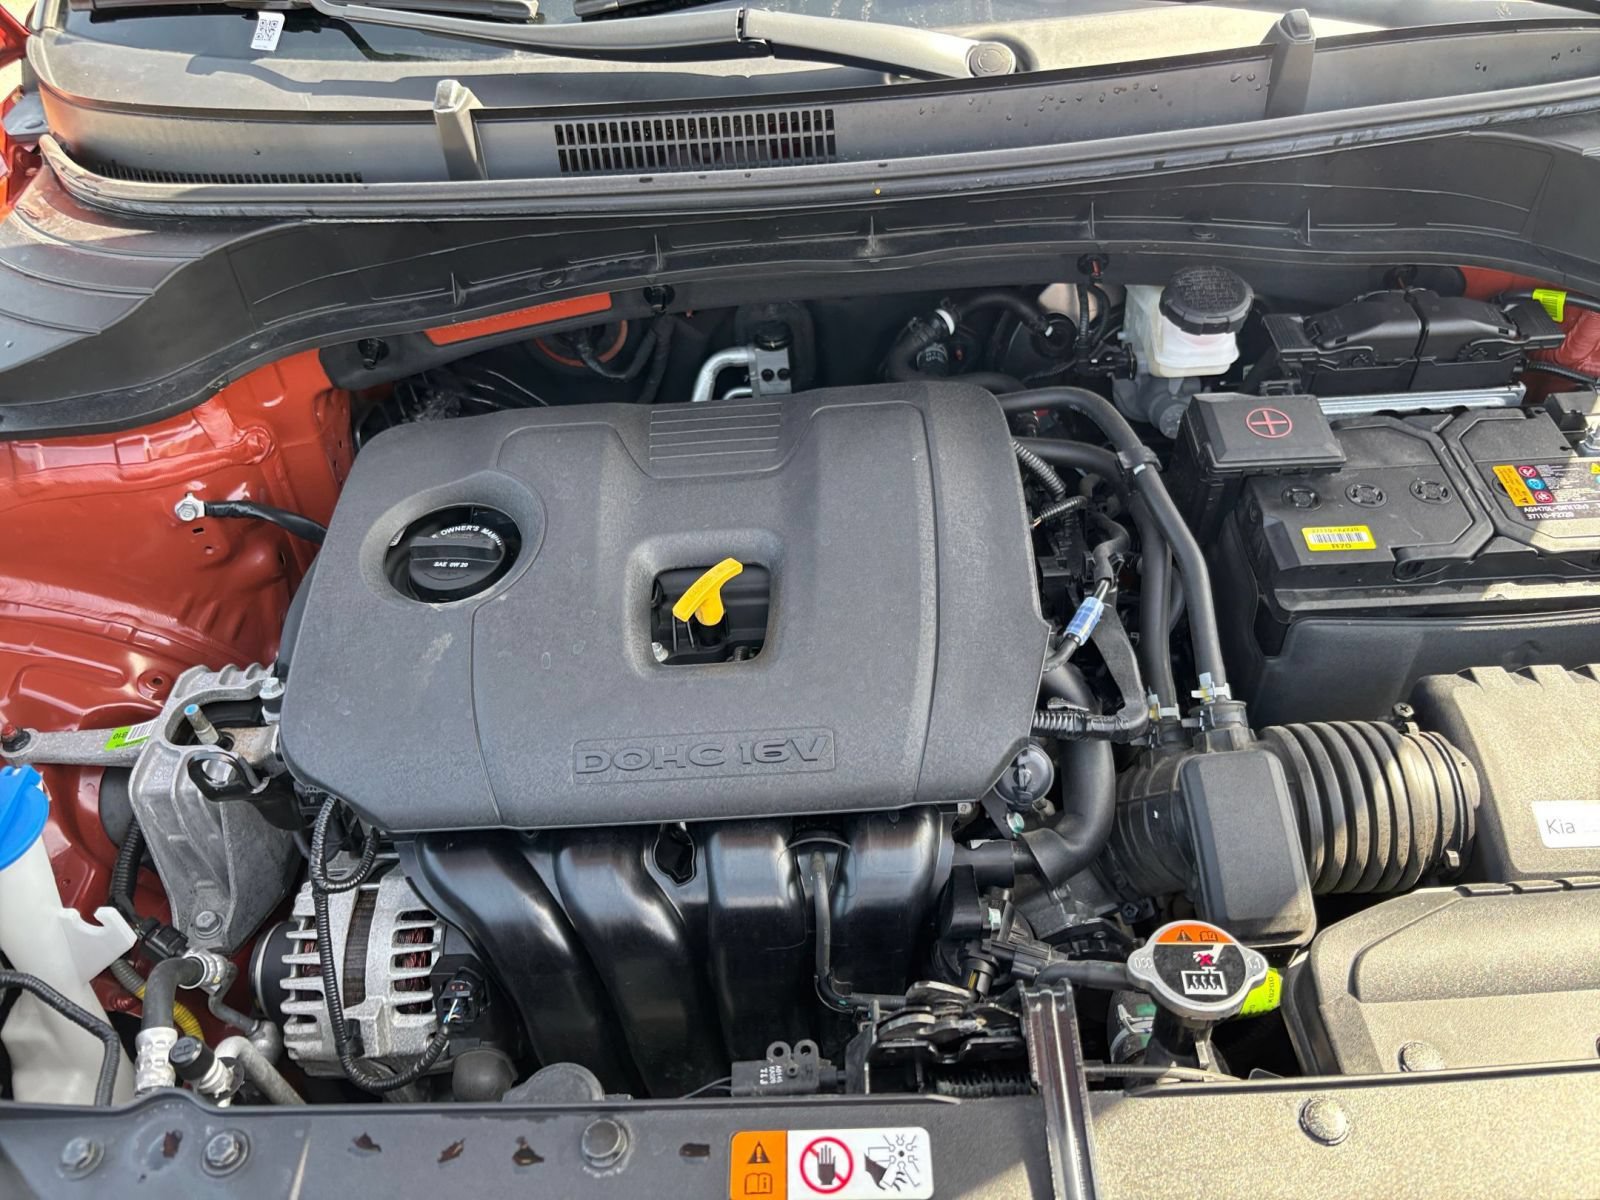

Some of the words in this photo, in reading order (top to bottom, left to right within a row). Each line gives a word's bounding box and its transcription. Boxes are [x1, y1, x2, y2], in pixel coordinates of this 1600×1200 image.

[440, 524, 481, 536] OWNER'S
[575, 743, 726, 775] DOHC
[739, 735, 830, 765] 16V
[1545, 818, 1576, 835] Kia
